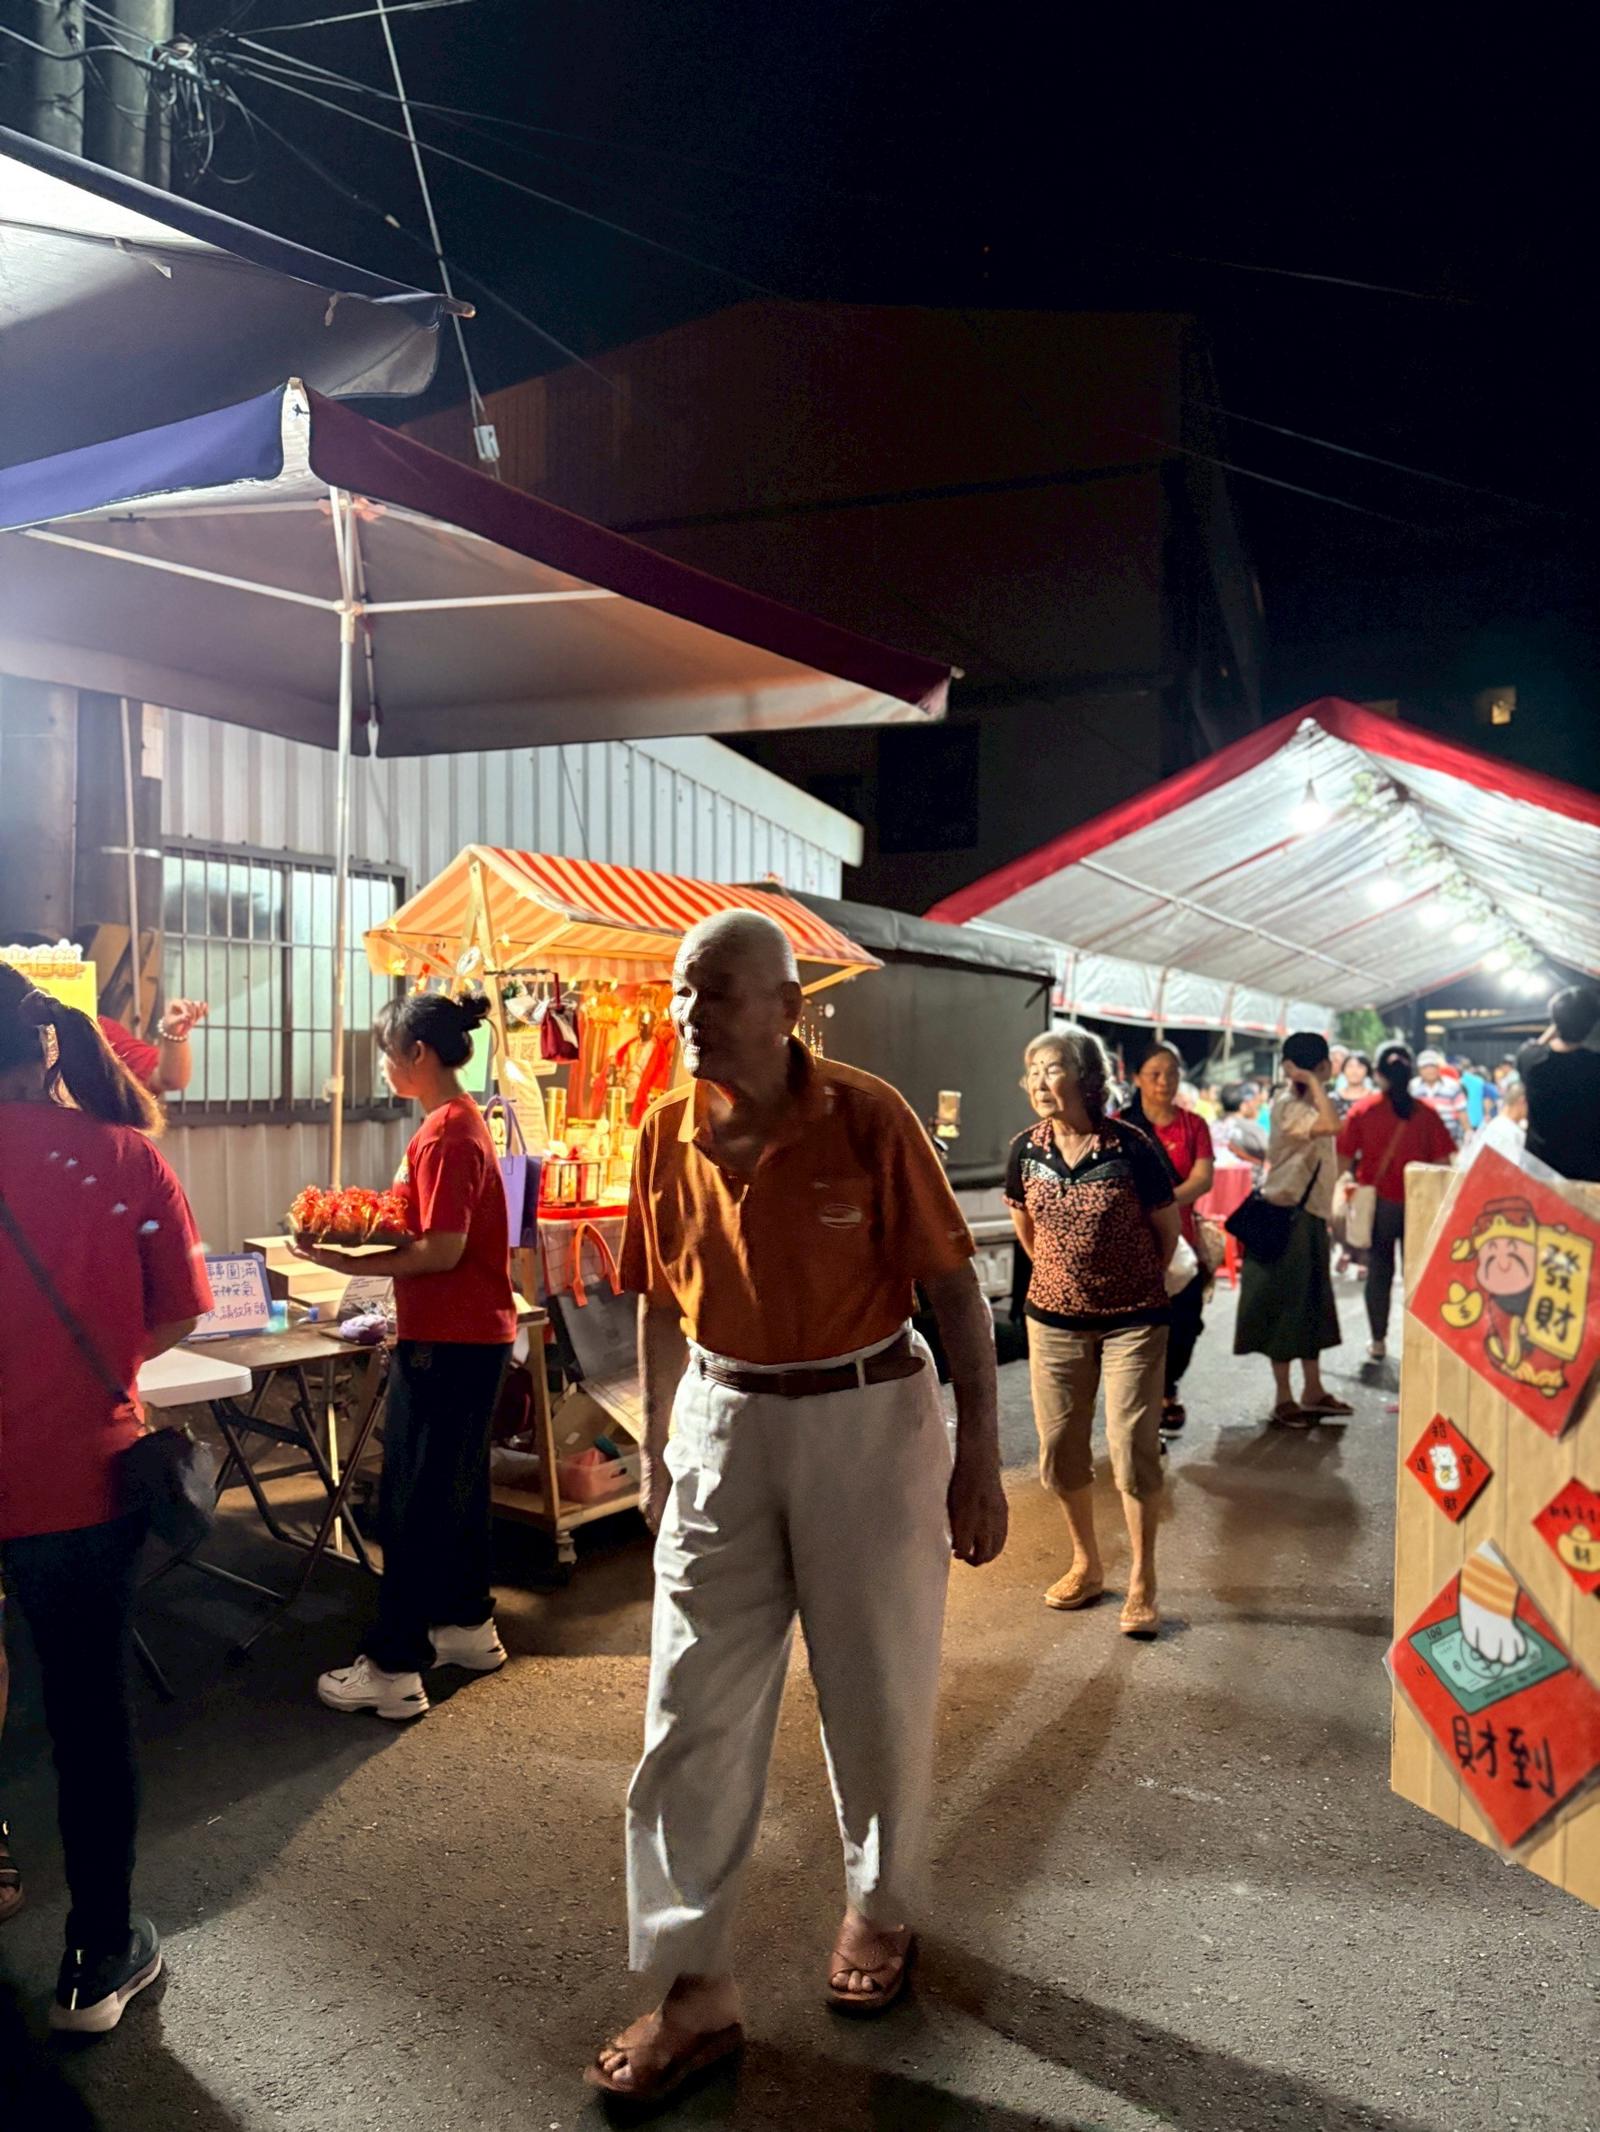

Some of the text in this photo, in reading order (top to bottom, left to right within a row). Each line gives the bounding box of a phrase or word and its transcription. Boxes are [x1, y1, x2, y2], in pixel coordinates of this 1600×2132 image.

[1535, 1243, 1580, 1342] 發財
[1426, 1626, 1443, 1640] 100
[1452, 1715, 1556, 1798] 財到
